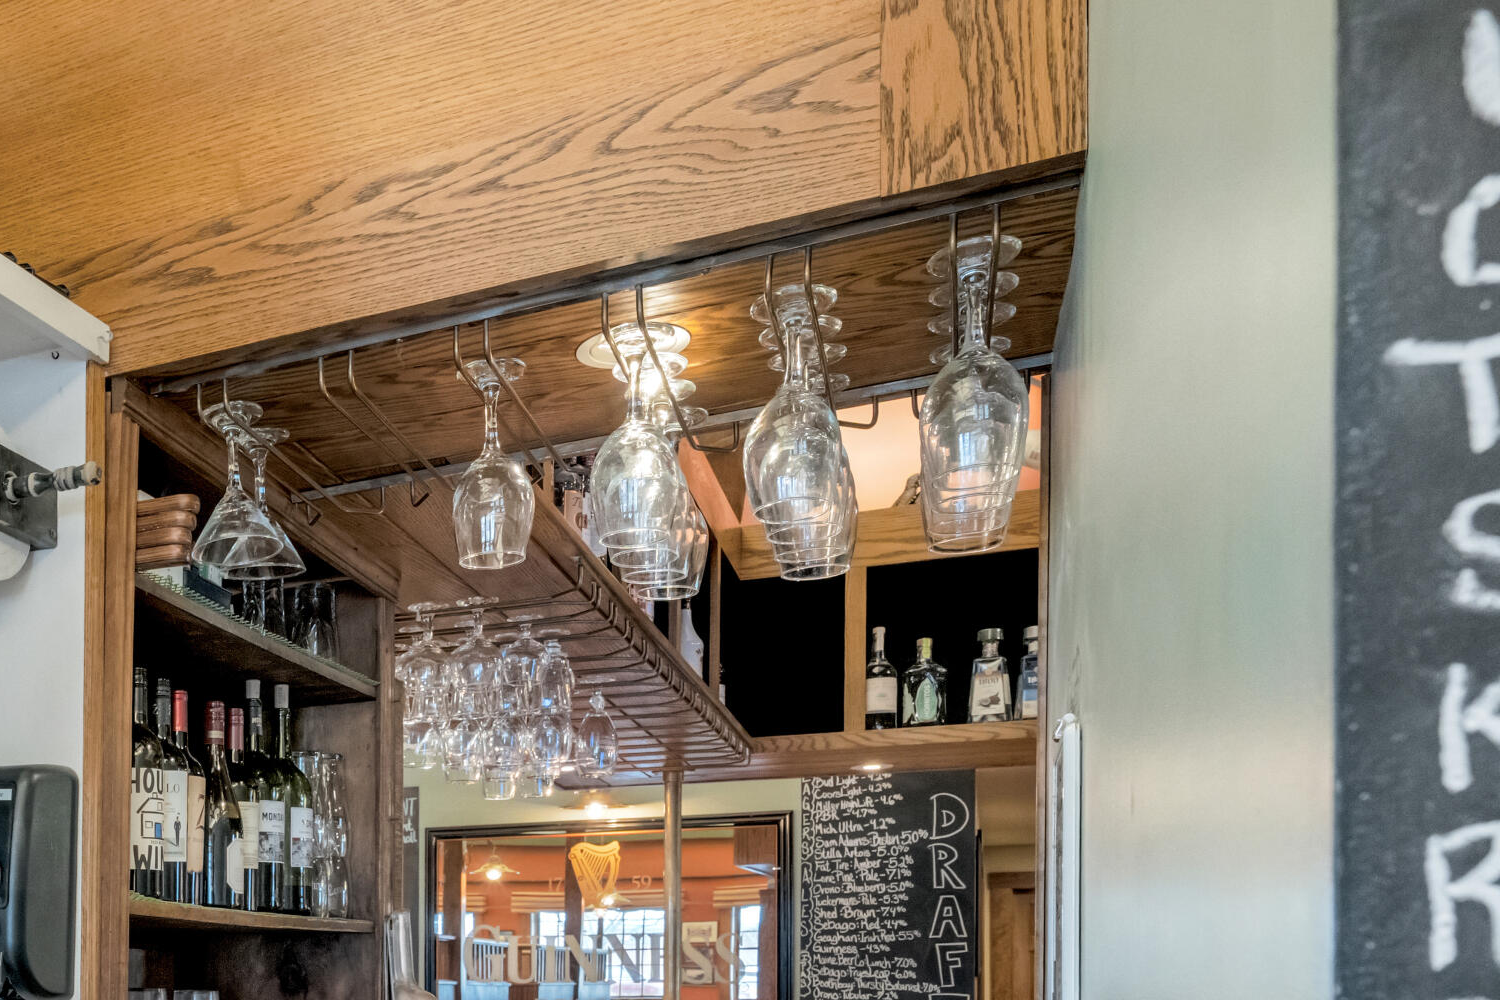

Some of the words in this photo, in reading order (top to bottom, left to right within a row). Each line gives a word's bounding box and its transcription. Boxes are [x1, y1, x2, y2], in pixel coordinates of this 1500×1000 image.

[815, 809, 840, 822] PBR
[838, 820, 864, 832] Ultra
[815, 836, 838, 848] Sam
[814, 846, 842, 860] Stella
[843, 847, 871, 858] Artois
[815, 860, 831, 872] Fat
[631, 875, 652, 889] 59
[813, 941, 858, 953] Guinness
